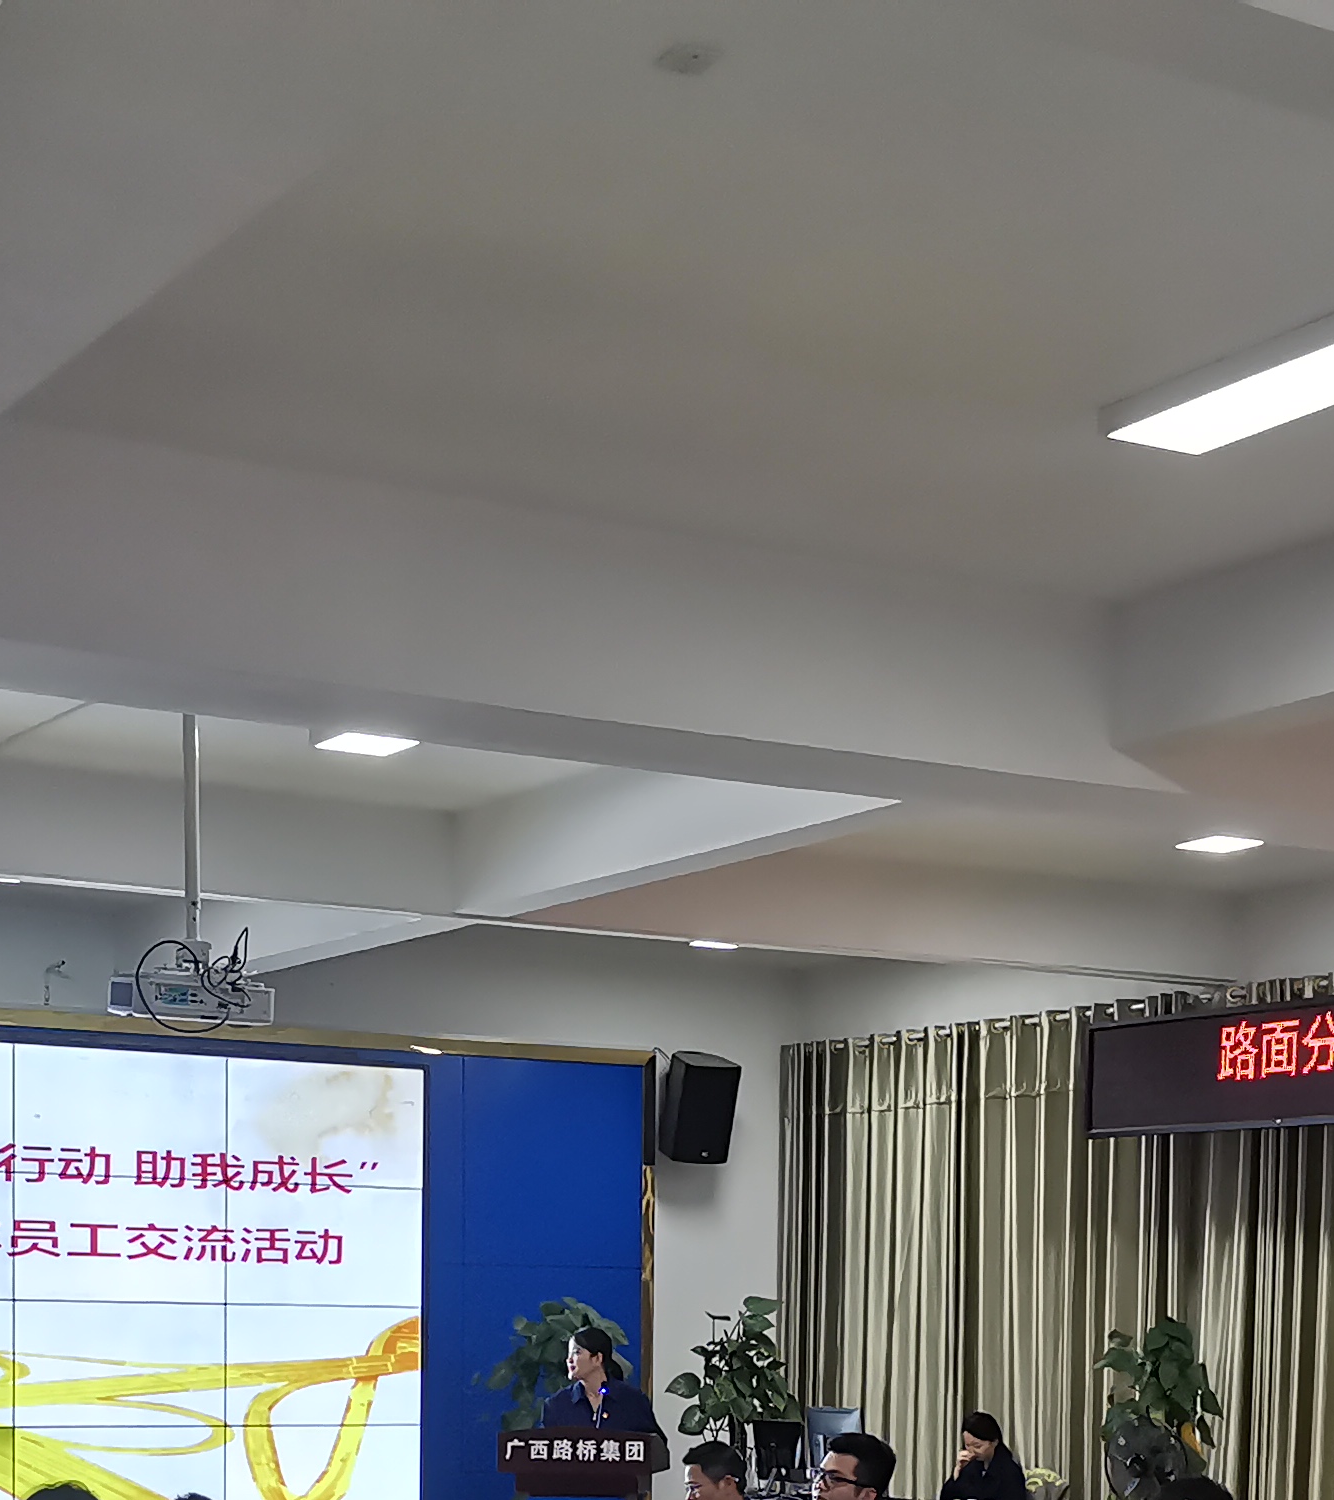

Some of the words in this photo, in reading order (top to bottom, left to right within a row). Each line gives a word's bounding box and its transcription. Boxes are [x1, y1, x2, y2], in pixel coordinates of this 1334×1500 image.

[505, 1438, 645, 1462] 广西路桥集团
